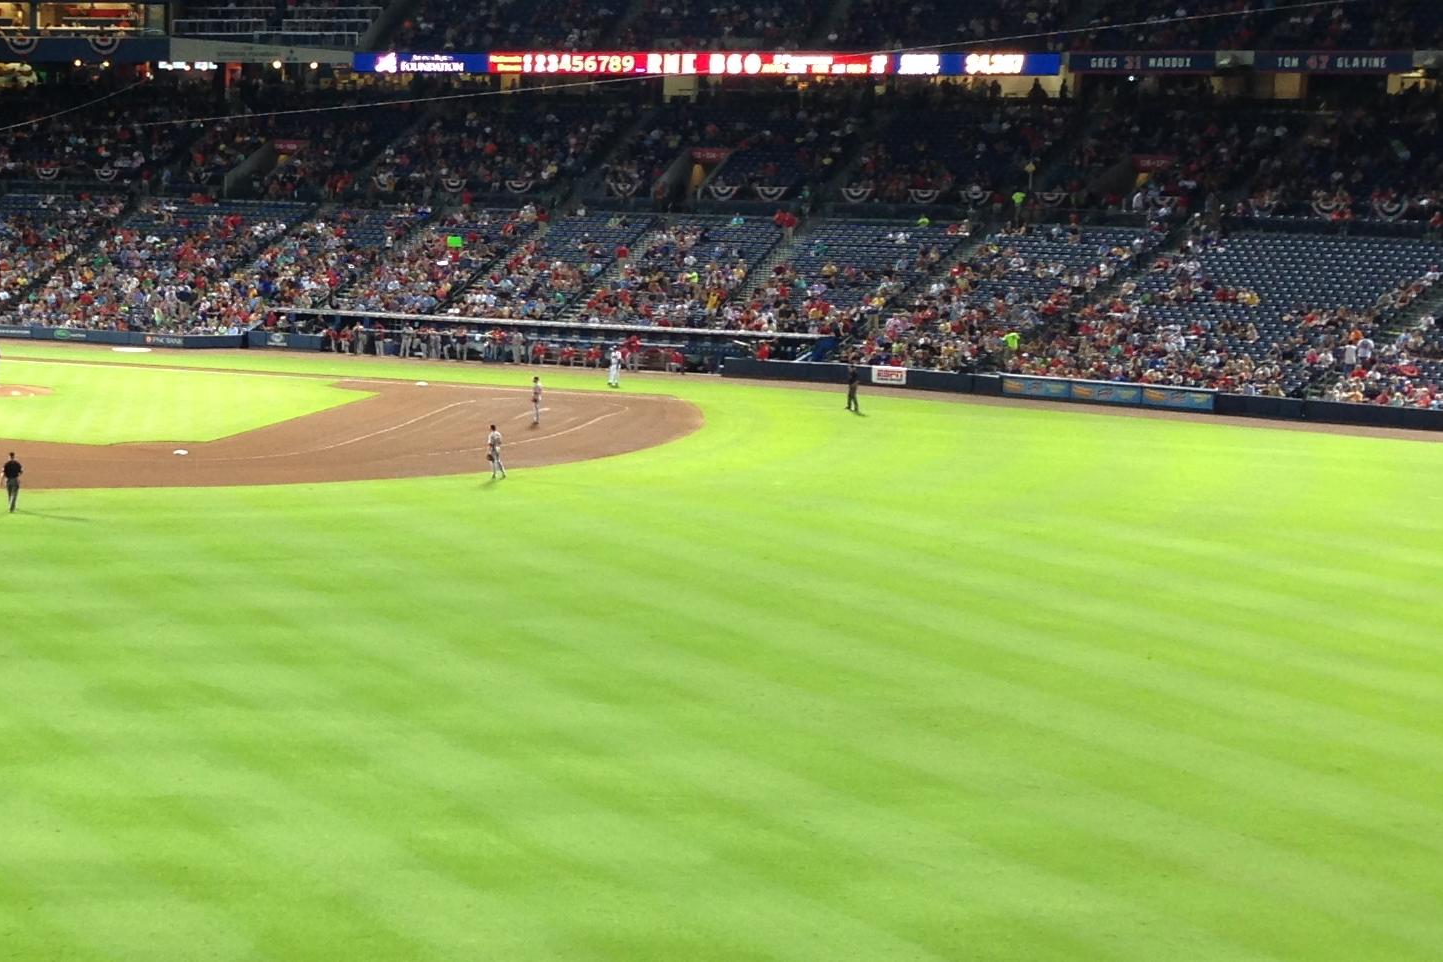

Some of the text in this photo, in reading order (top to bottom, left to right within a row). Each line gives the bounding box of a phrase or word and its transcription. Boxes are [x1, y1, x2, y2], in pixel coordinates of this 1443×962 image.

[400, 61, 465, 72] FOUNDATION
[1090, 57, 1118, 68] GREG
[1148, 57, 1192, 68] MADDUX
[1276, 56, 1300, 68] TOM
[1336, 56, 1388, 69] GLAVINE
